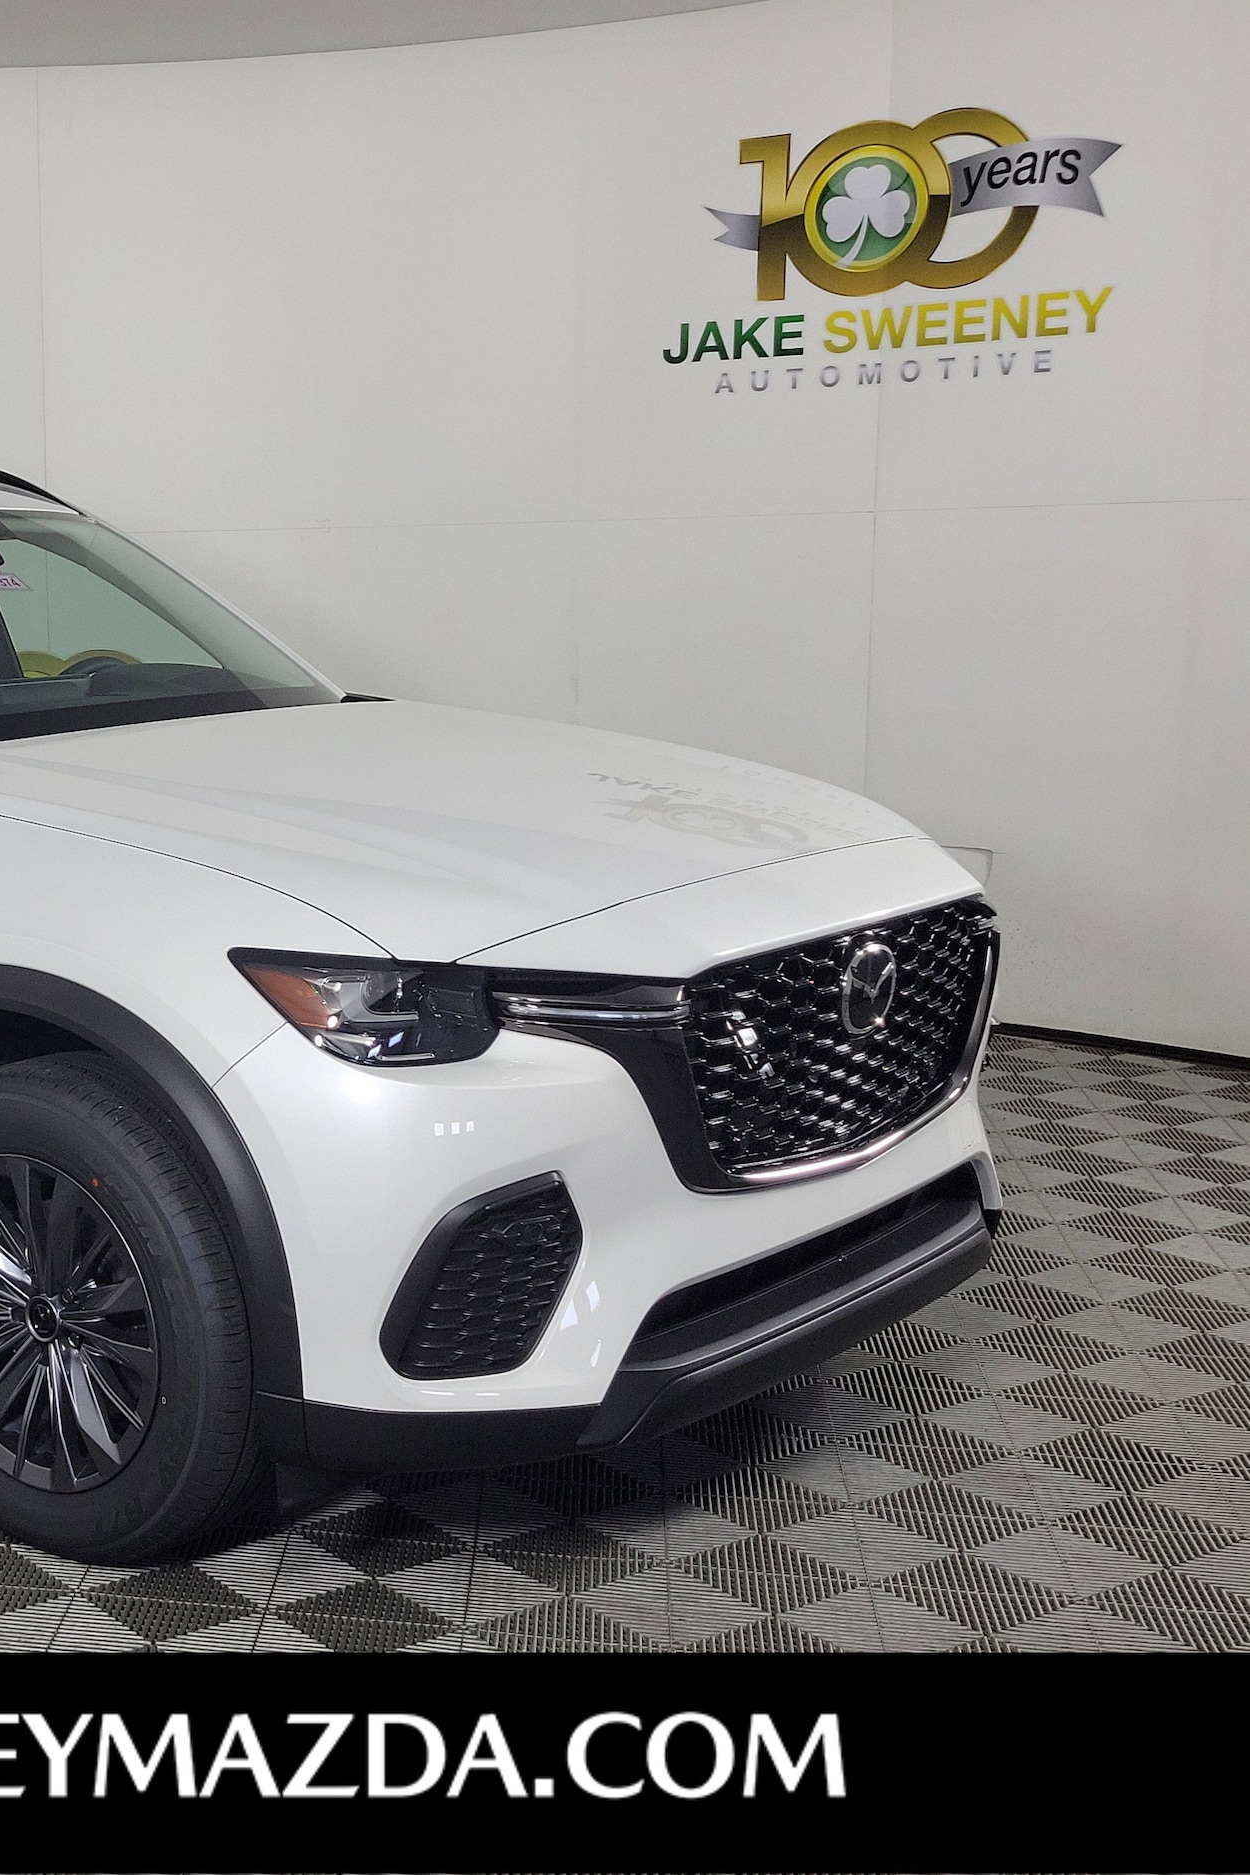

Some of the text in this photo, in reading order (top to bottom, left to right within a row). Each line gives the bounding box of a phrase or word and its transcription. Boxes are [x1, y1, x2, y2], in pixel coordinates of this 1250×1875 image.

[739, 107, 1082, 302] 100 years
[663, 286, 1113, 364] JAKE SWEENEY
[714, 350, 1052, 394] AUTOMOTIVE
